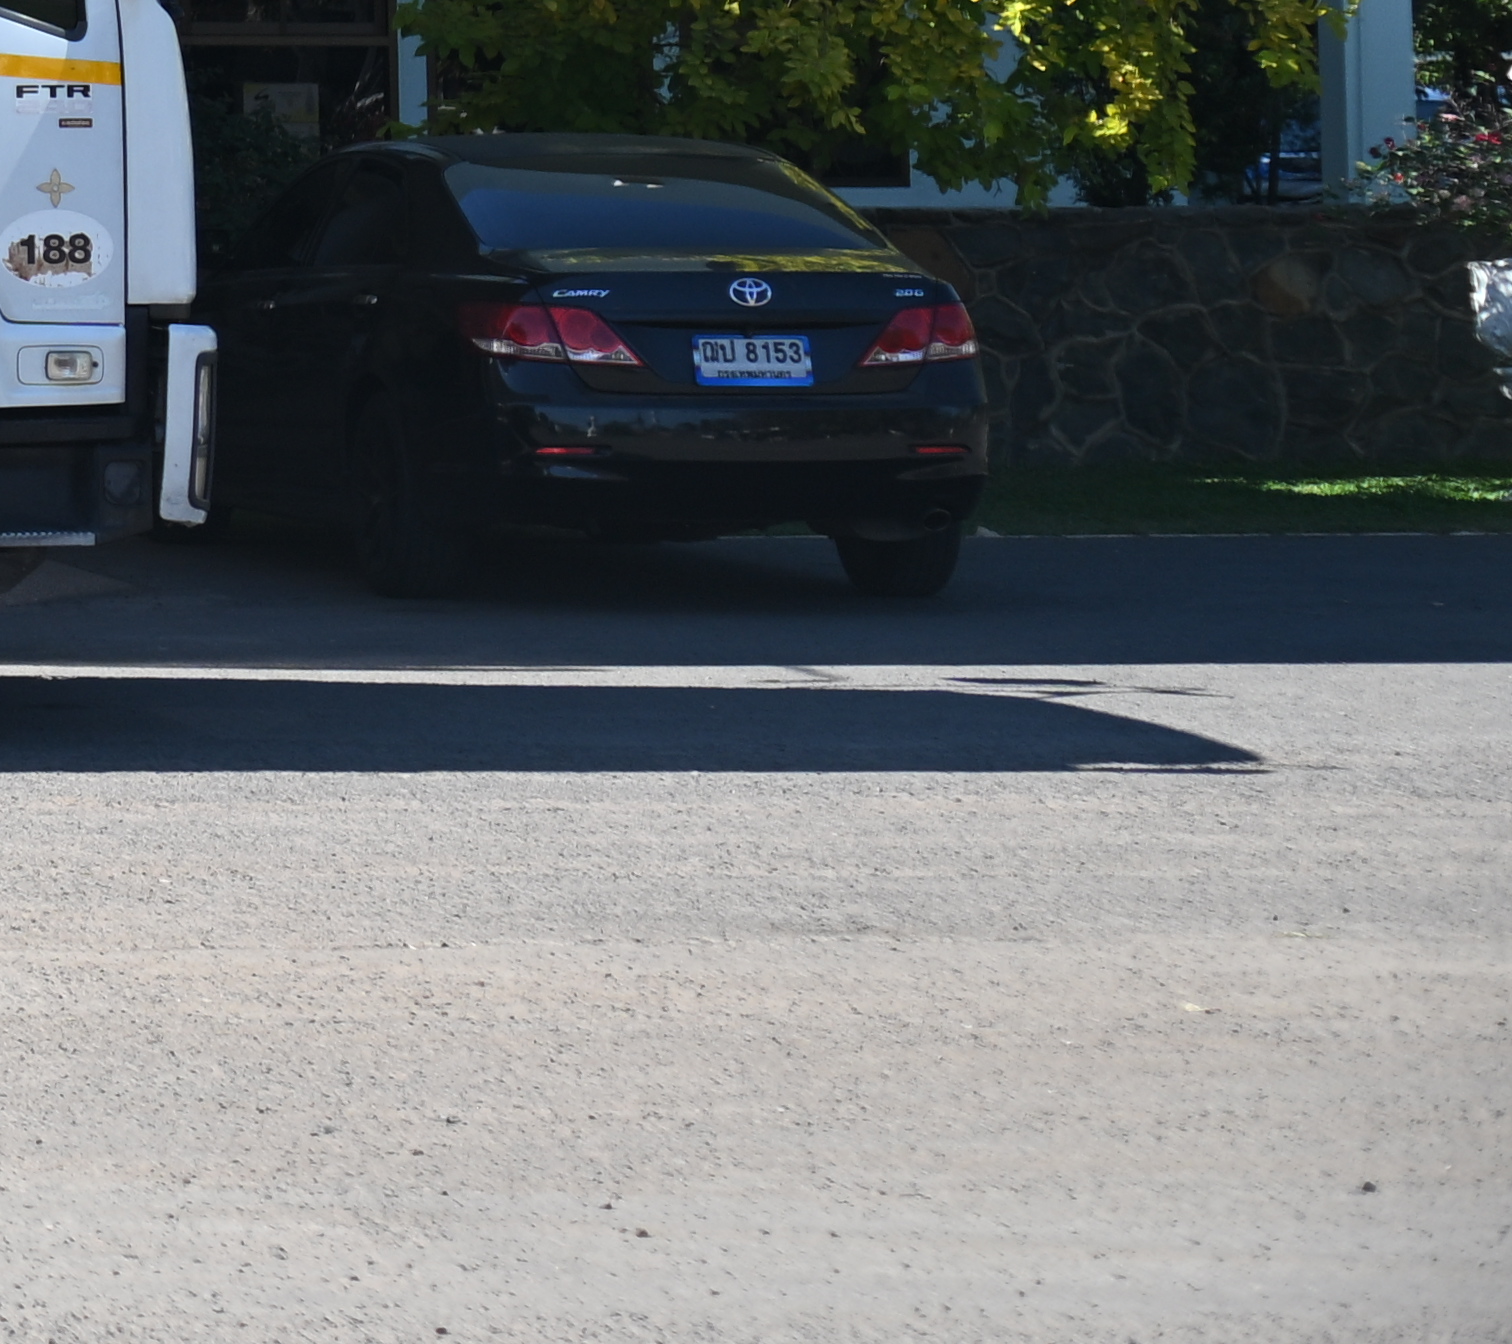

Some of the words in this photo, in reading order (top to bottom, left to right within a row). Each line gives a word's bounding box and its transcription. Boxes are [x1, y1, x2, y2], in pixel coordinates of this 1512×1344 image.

[16, 84, 91, 98] FTR
[20, 233, 92, 265] 188
[552, 288, 610, 298] CAMRY
[745, 341, 802, 363] 8153
